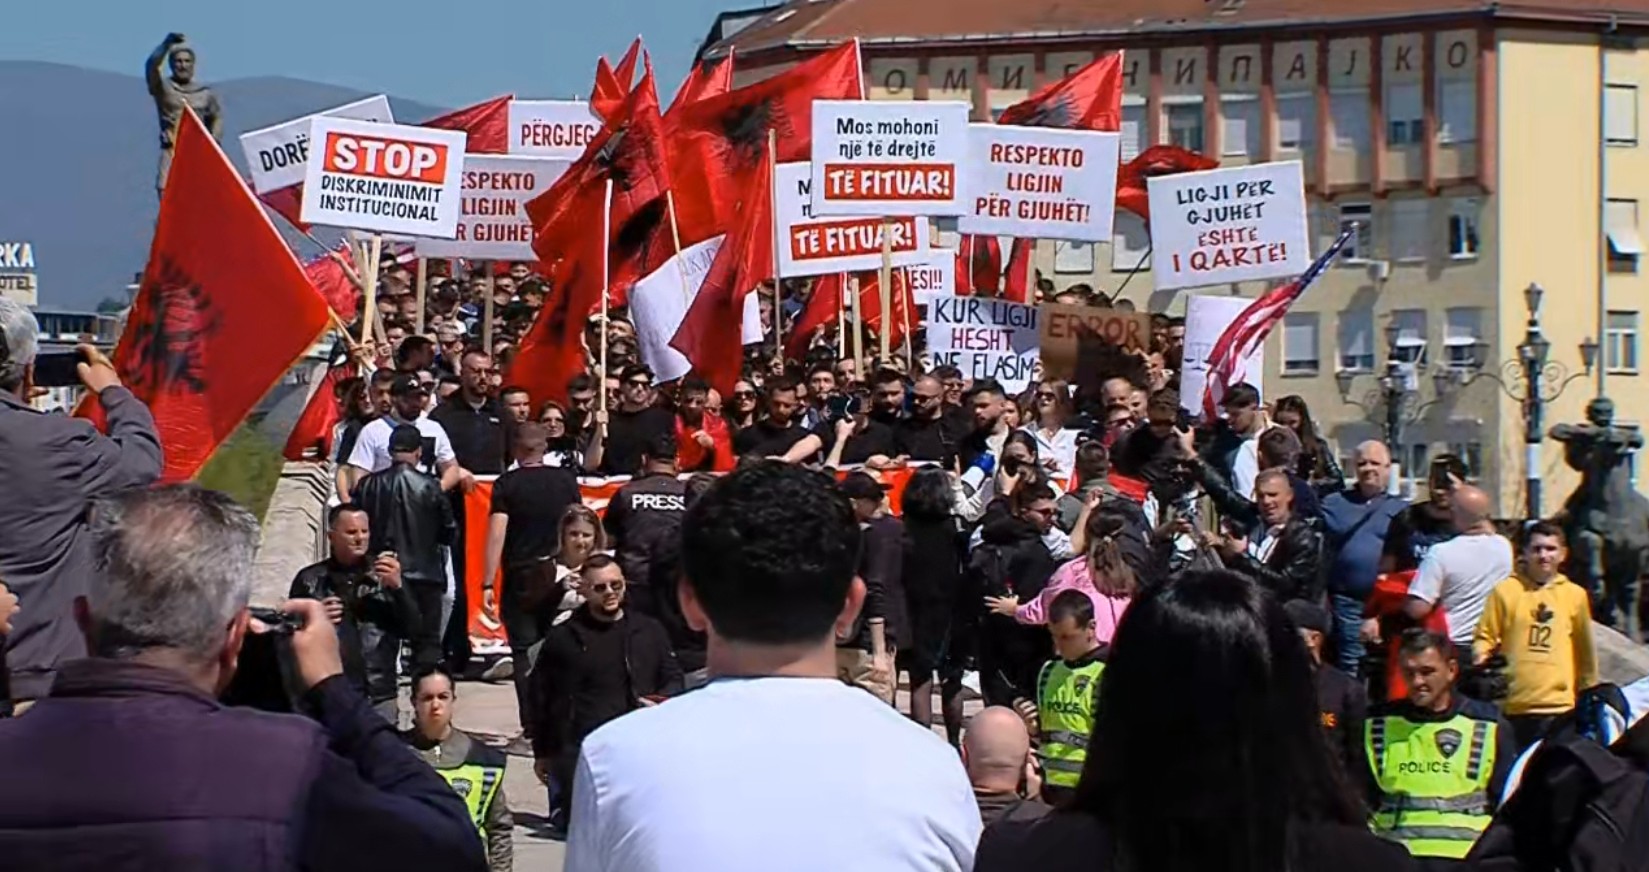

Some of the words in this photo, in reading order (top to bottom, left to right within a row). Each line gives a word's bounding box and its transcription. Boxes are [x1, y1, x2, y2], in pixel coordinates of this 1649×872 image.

[521, 118, 595, 147] PËRGJEG
[836, 117, 873, 135] Mos
[877, 118, 939, 135] mohoni
[259, 133, 311, 172] DORË
[332, 137, 438, 178] STOP
[839, 141, 862, 160] një
[868, 140, 883, 157] të
[887, 139, 936, 160] drejtë
[990, 143, 1084, 168] RESPEKTO
[321, 175, 443, 204] DISKRIMINIMIT
[460, 171, 535, 191] ESPEKTO
[829, 170, 855, 195] TË
[860, 169, 950, 196] FITUAR!
[1006, 172, 1064, 194] LIGJIN
[1176, 185, 1229, 205] LIGJI
[1236, 180, 1276, 199] PËR
[319, 194, 440, 221] INSTITUCIONAL
[461, 197, 516, 216] LIGJIN
[975, 192, 1012, 218] PËR
[1017, 197, 1090, 224] GJUHËT!
[1186, 202, 1266, 225] GJUHËT
[793, 229, 822, 255] TË
[1198, 226, 1259, 248] ËSHTË
[1173, 254, 1181, 273] I
[1190, 243, 1288, 272] QARTË!
[910, 263, 943, 290] ËSI!!
[934, 298, 985, 325] KUR
[992, 300, 1037, 330] LIGJI
[950, 327, 1015, 351] HESHT
[972, 352, 1036, 381] FLASIM
[631, 493, 687, 511] PRESS
[1398, 760, 1452, 774] POLICE
